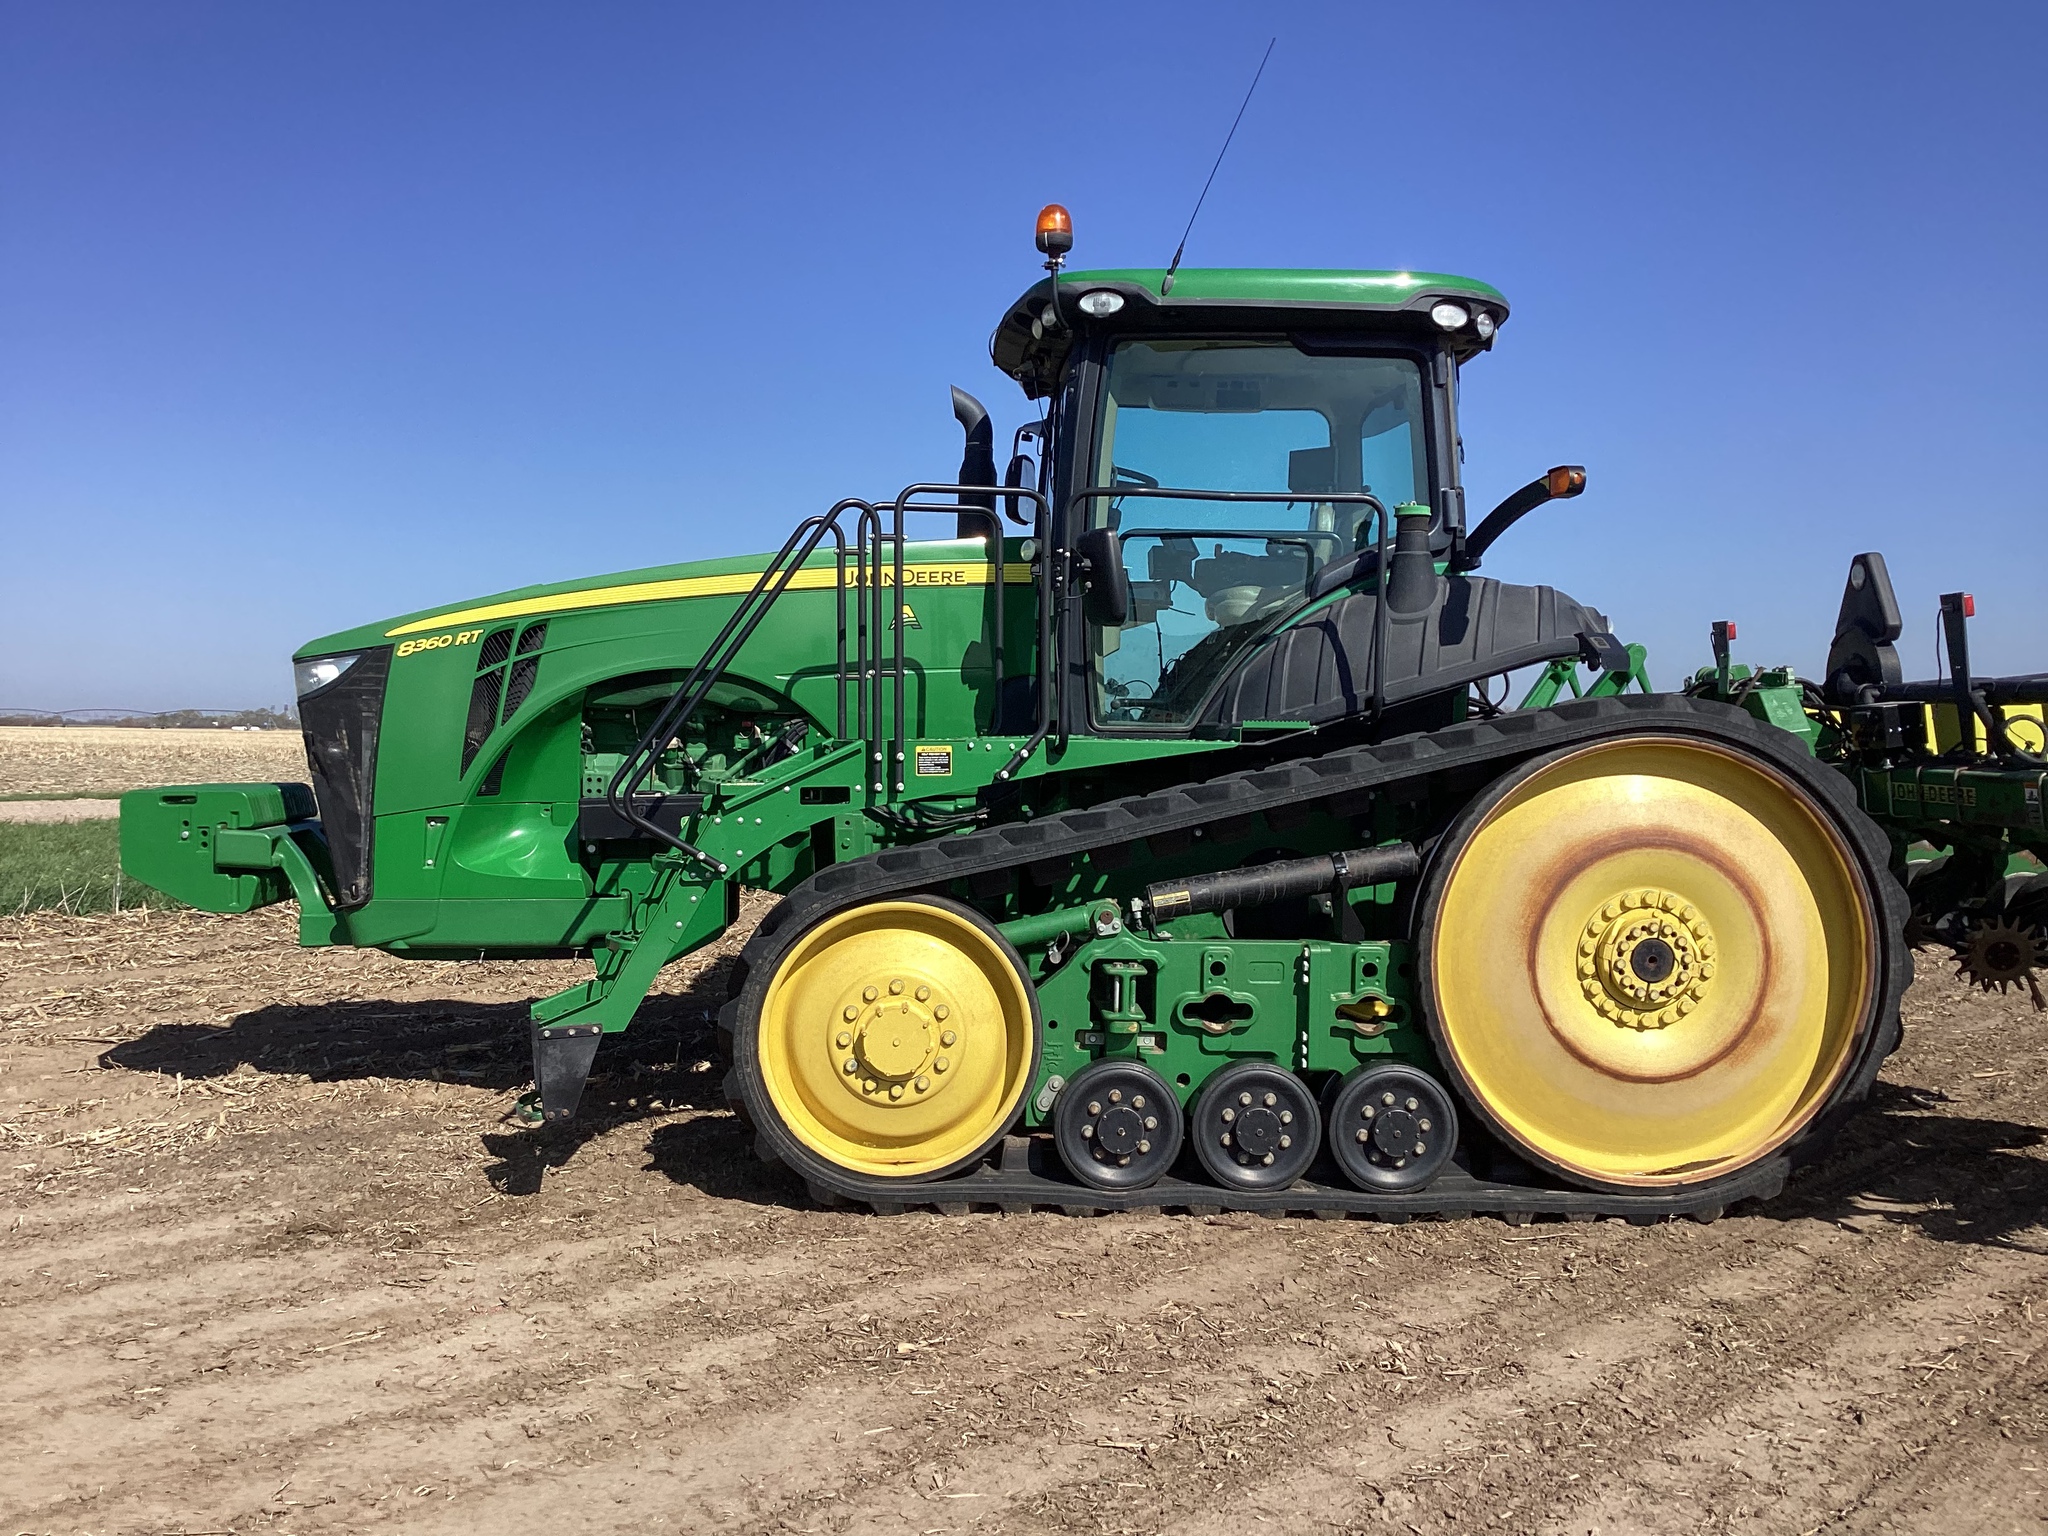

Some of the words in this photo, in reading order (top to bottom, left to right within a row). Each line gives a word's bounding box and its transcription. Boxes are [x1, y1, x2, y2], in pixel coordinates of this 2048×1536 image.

[901, 569, 966, 584] DEERE
[396, 634, 453, 657] 8360
[455, 629, 485, 646] RT
